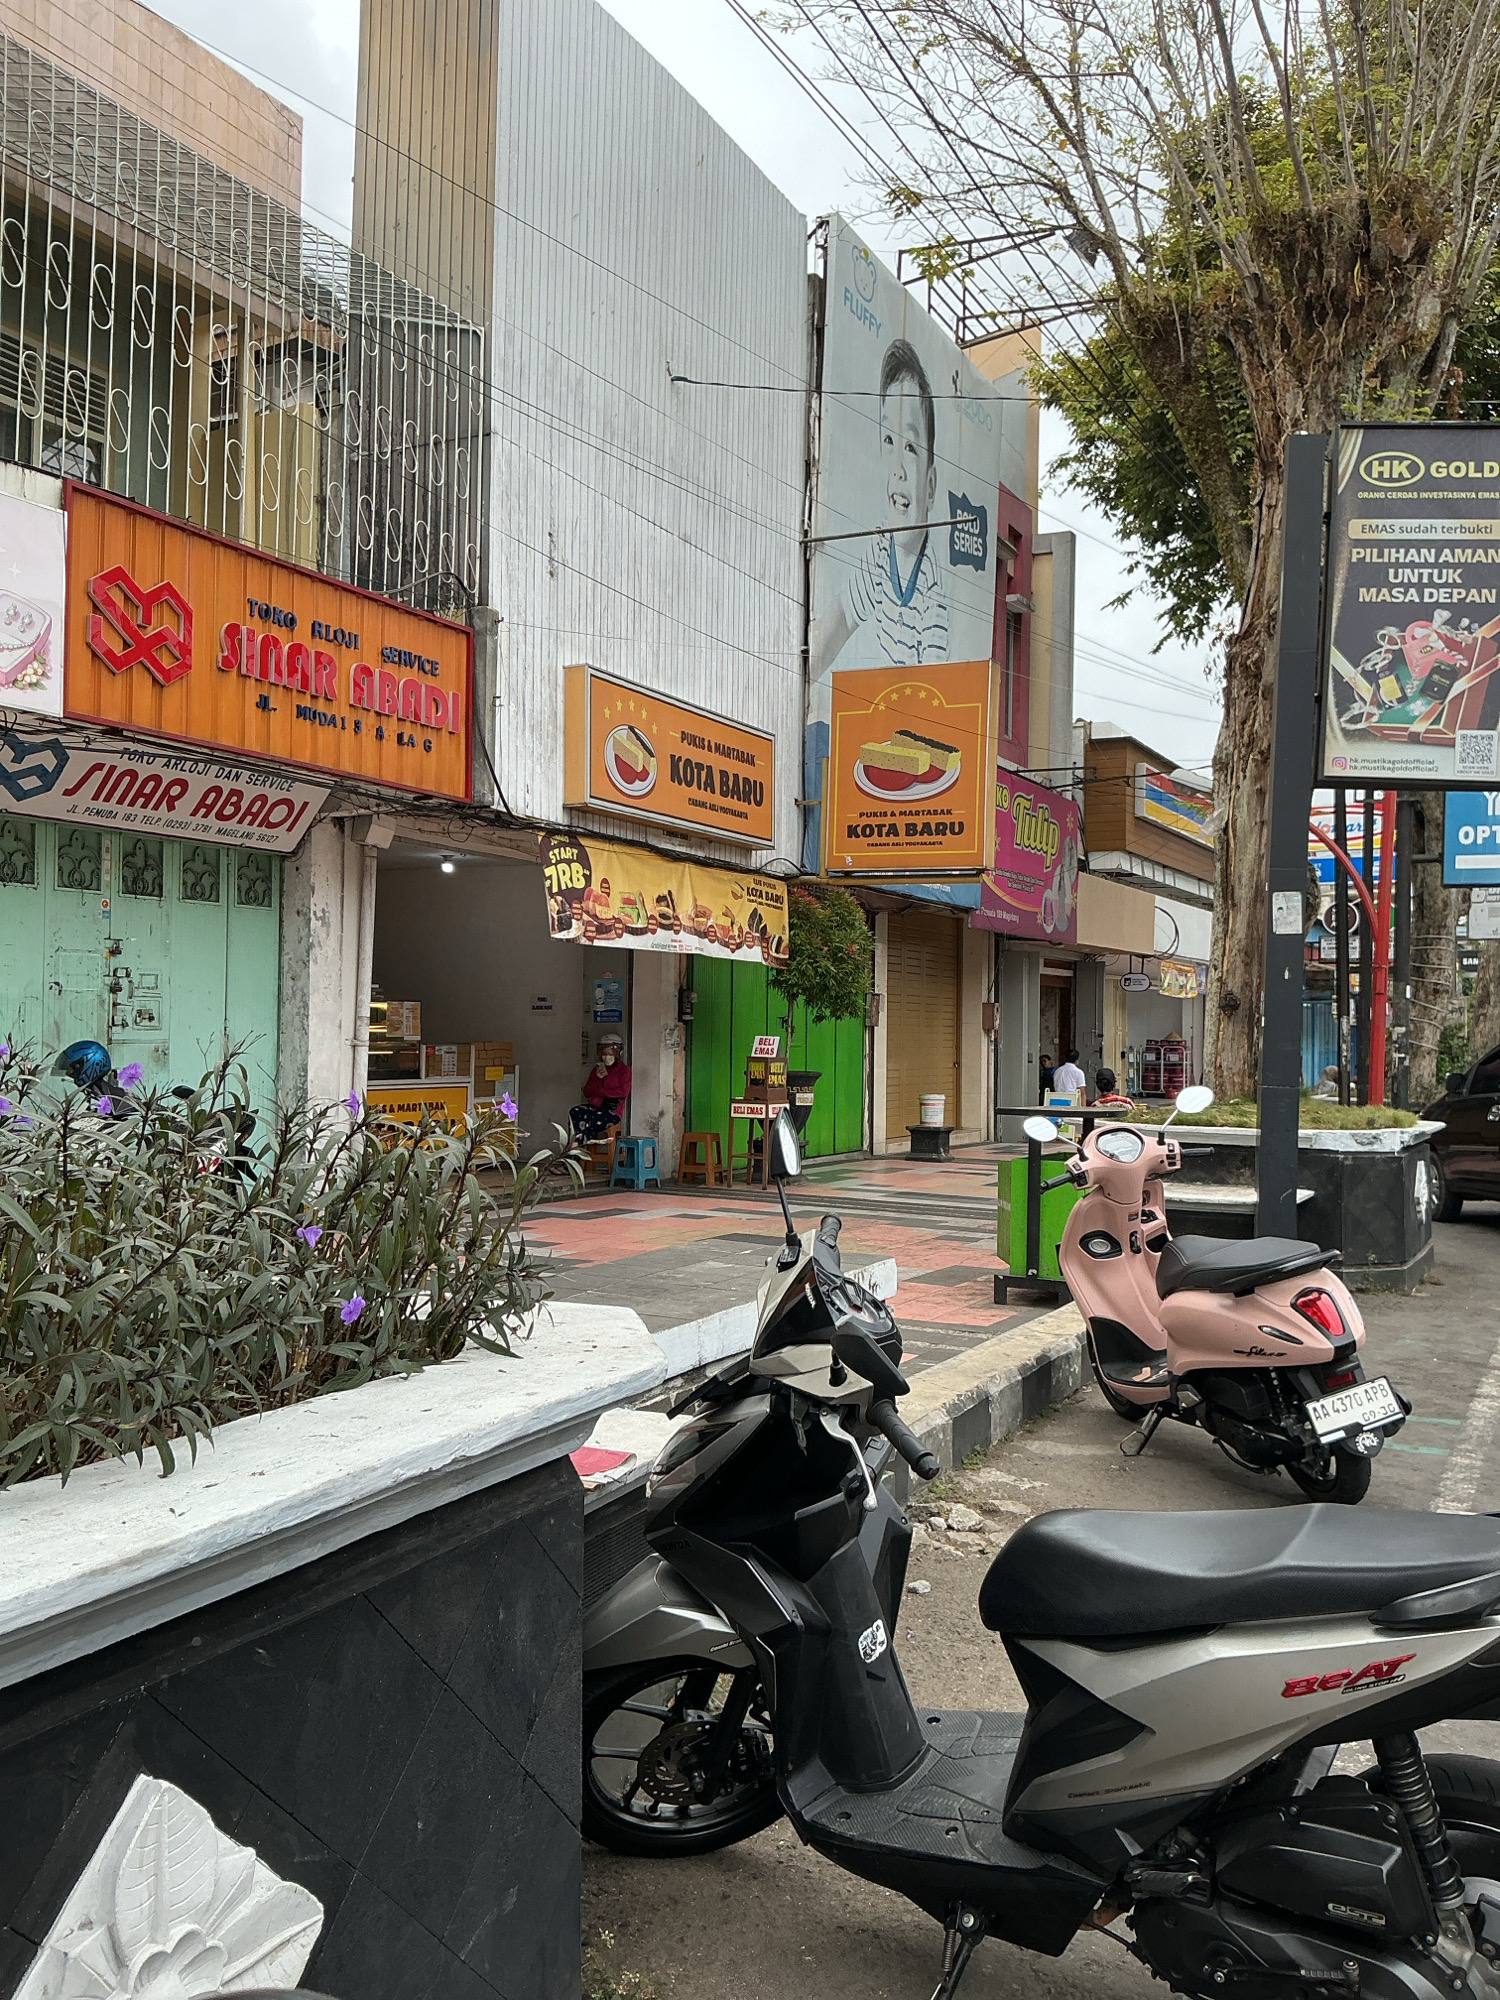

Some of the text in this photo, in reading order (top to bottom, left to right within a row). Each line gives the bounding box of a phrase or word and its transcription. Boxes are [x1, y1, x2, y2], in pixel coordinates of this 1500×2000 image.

[843, 286, 882, 339] FLUFFY
[1371, 459, 1500, 479] HK GOLD
[1357, 491, 1500, 499] ORANG CERDAS INVESTASINYA EMAS
[956, 509, 980, 535] BOLD
[1361, 523, 1493, 535] EMAS sudah terbukti
[953, 530, 983, 558] SERIES
[1351, 548, 1500, 564] PILIHAN AMAN
[1388, 568, 1463, 584] UNTUK
[1358, 587, 1497, 604] MASA DEPAN
[247, 598, 440, 676] TOKO RLOJI SERVICE
[217, 621, 461, 734] SINAR ABADI
[681, 730, 756, 767] PUKIS & MARTABAK
[119, 748, 297, 793] TOKO ARLOJI DAN SERVICE
[670, 753, 764, 808] KOTA BARU
[61, 762, 310, 833] SINAR ABADI
[859, 808, 953, 819] PUKIS & MARTABAK
[66, 803, 81, 815] JL.
[82, 806, 119, 821] PEMUDA
[121, 811, 139, 824] 183
[163, 818, 192, 832] (0293)
[192, 822, 213, 834] 3781
[214, 826, 256, 841] MAGELANG
[256, 833, 280, 844] 56127
[846, 820, 965, 839] KOTA BARU
[1011, 791, 1060, 873] Tulip
[548, 846, 579, 864] START
[544, 862, 586, 894] 7RB
[746, 886, 764, 900] KOTA
[765, 891, 784, 905] BARU
[758, 1037, 776, 1046] BELI
[753, 1047, 775, 1056] EMAS
[768, 1074, 787, 1085] EMAS
[733, 1105, 746, 1115] BELI
[746, 1106, 764, 1116] EMAS
[1312, 1403, 1332, 1421] AA
[1331, 1392, 1364, 1415] 4370
[659, 1539, 692, 1551] HONDA
